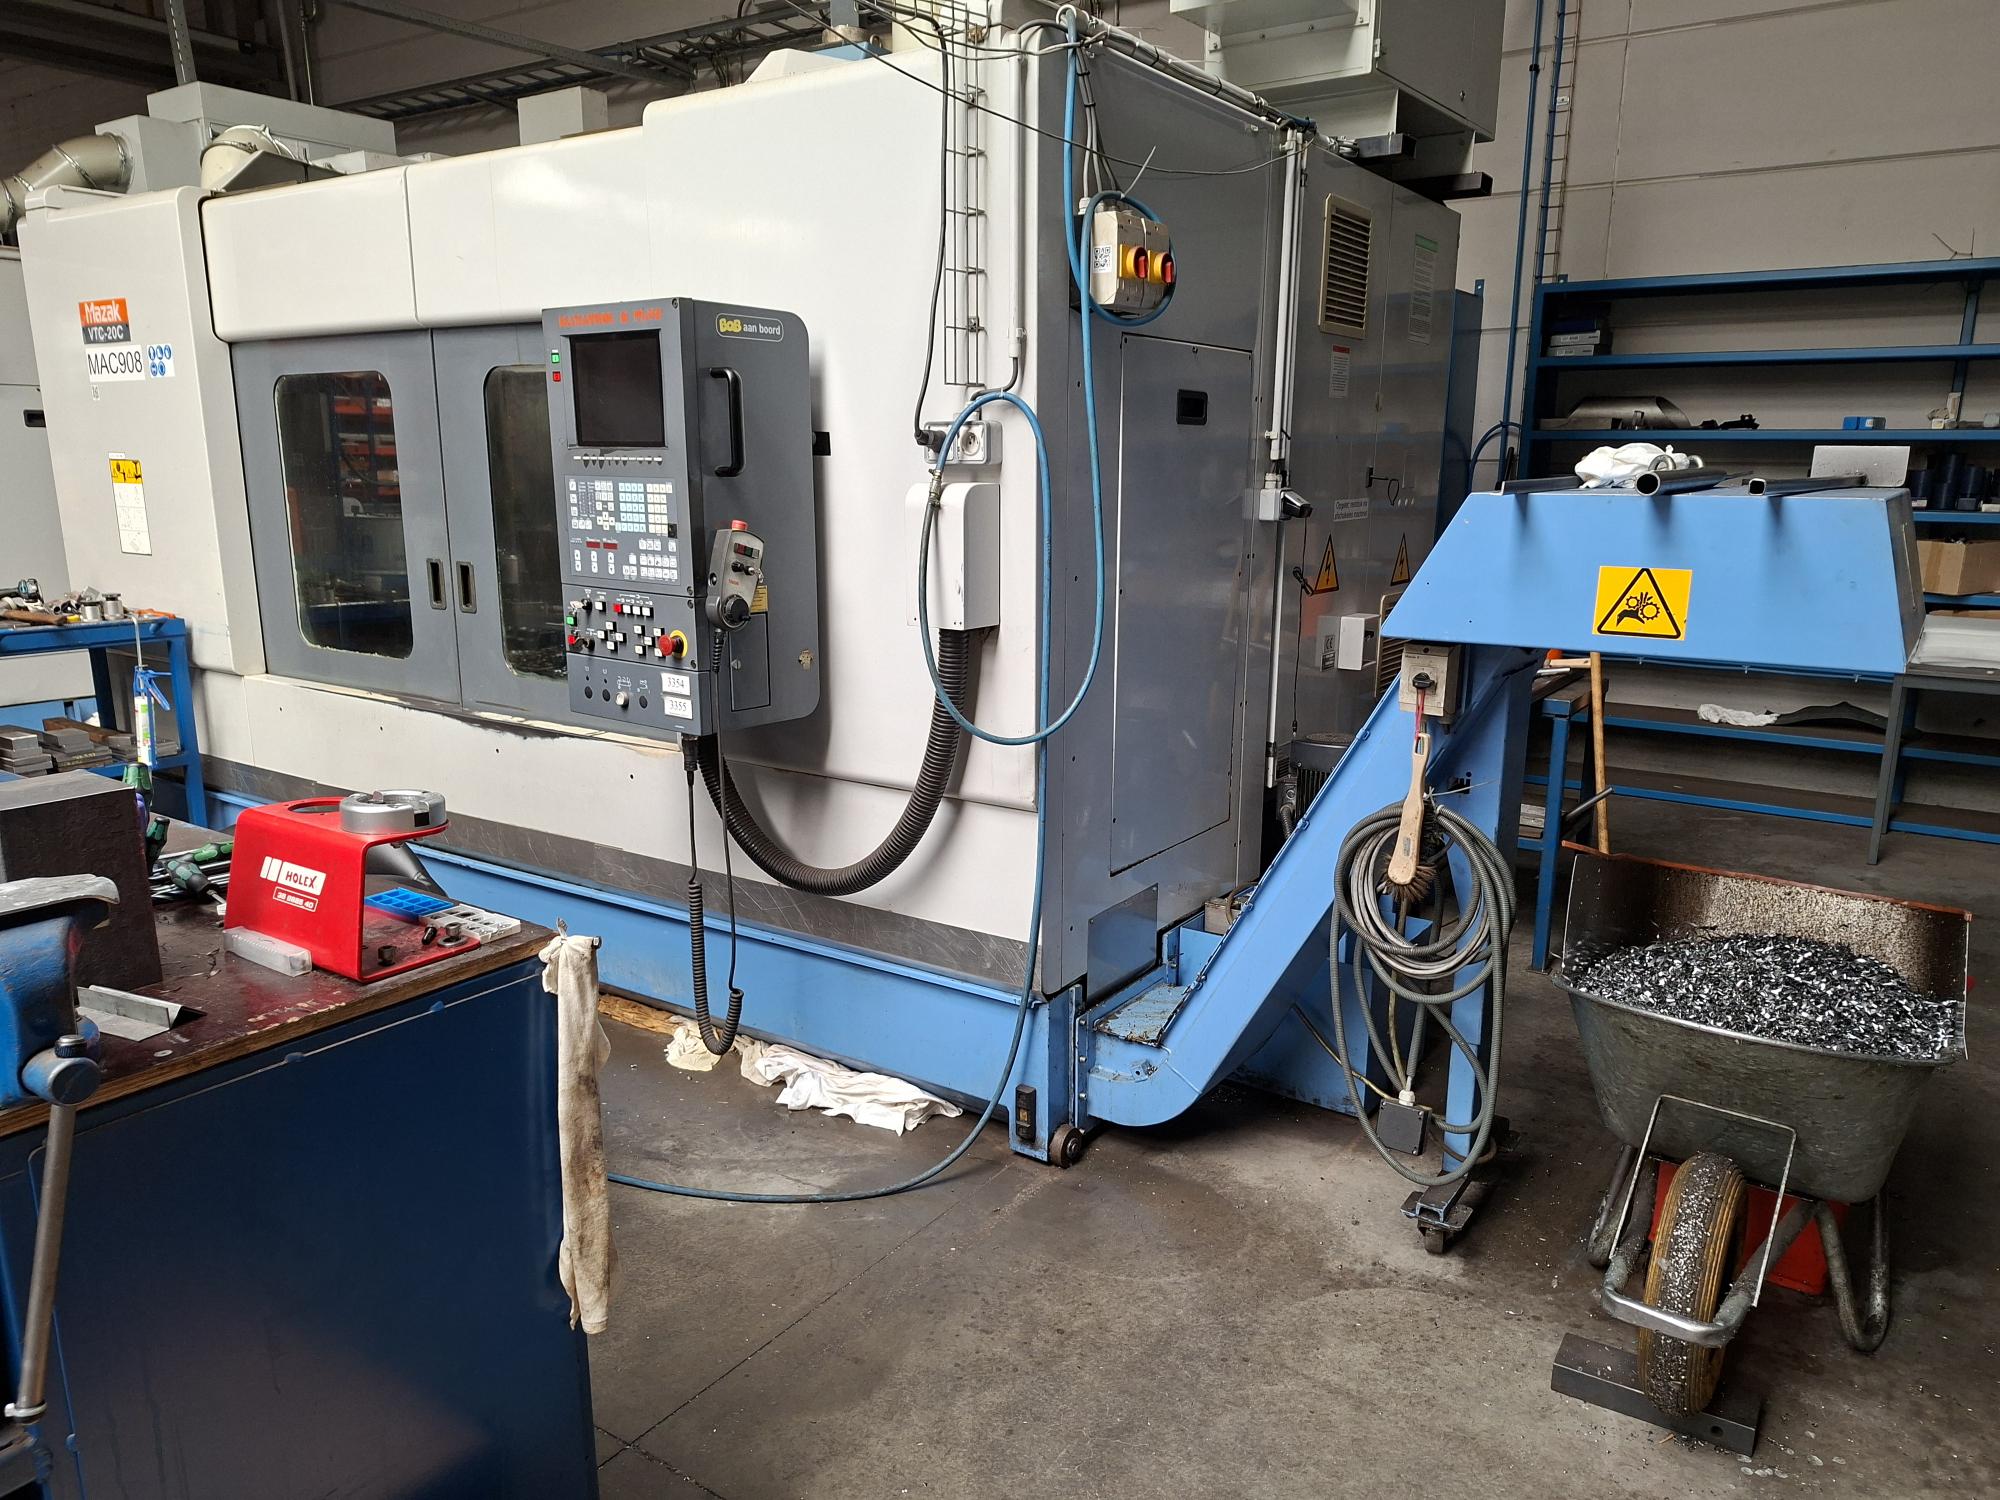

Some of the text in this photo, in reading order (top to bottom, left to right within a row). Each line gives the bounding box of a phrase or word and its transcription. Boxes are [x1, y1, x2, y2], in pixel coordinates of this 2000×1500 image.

[84, 299, 122, 324] Mazak
[88, 325, 124, 341] VTC-20C
[743, 323, 757, 333] aan
[758, 323, 781, 336] boord
[87, 350, 143, 376] MAC908
[667, 676, 685, 689] 3354
[669, 699, 687, 712] 3355
[285, 870, 317, 889] HOLEX
